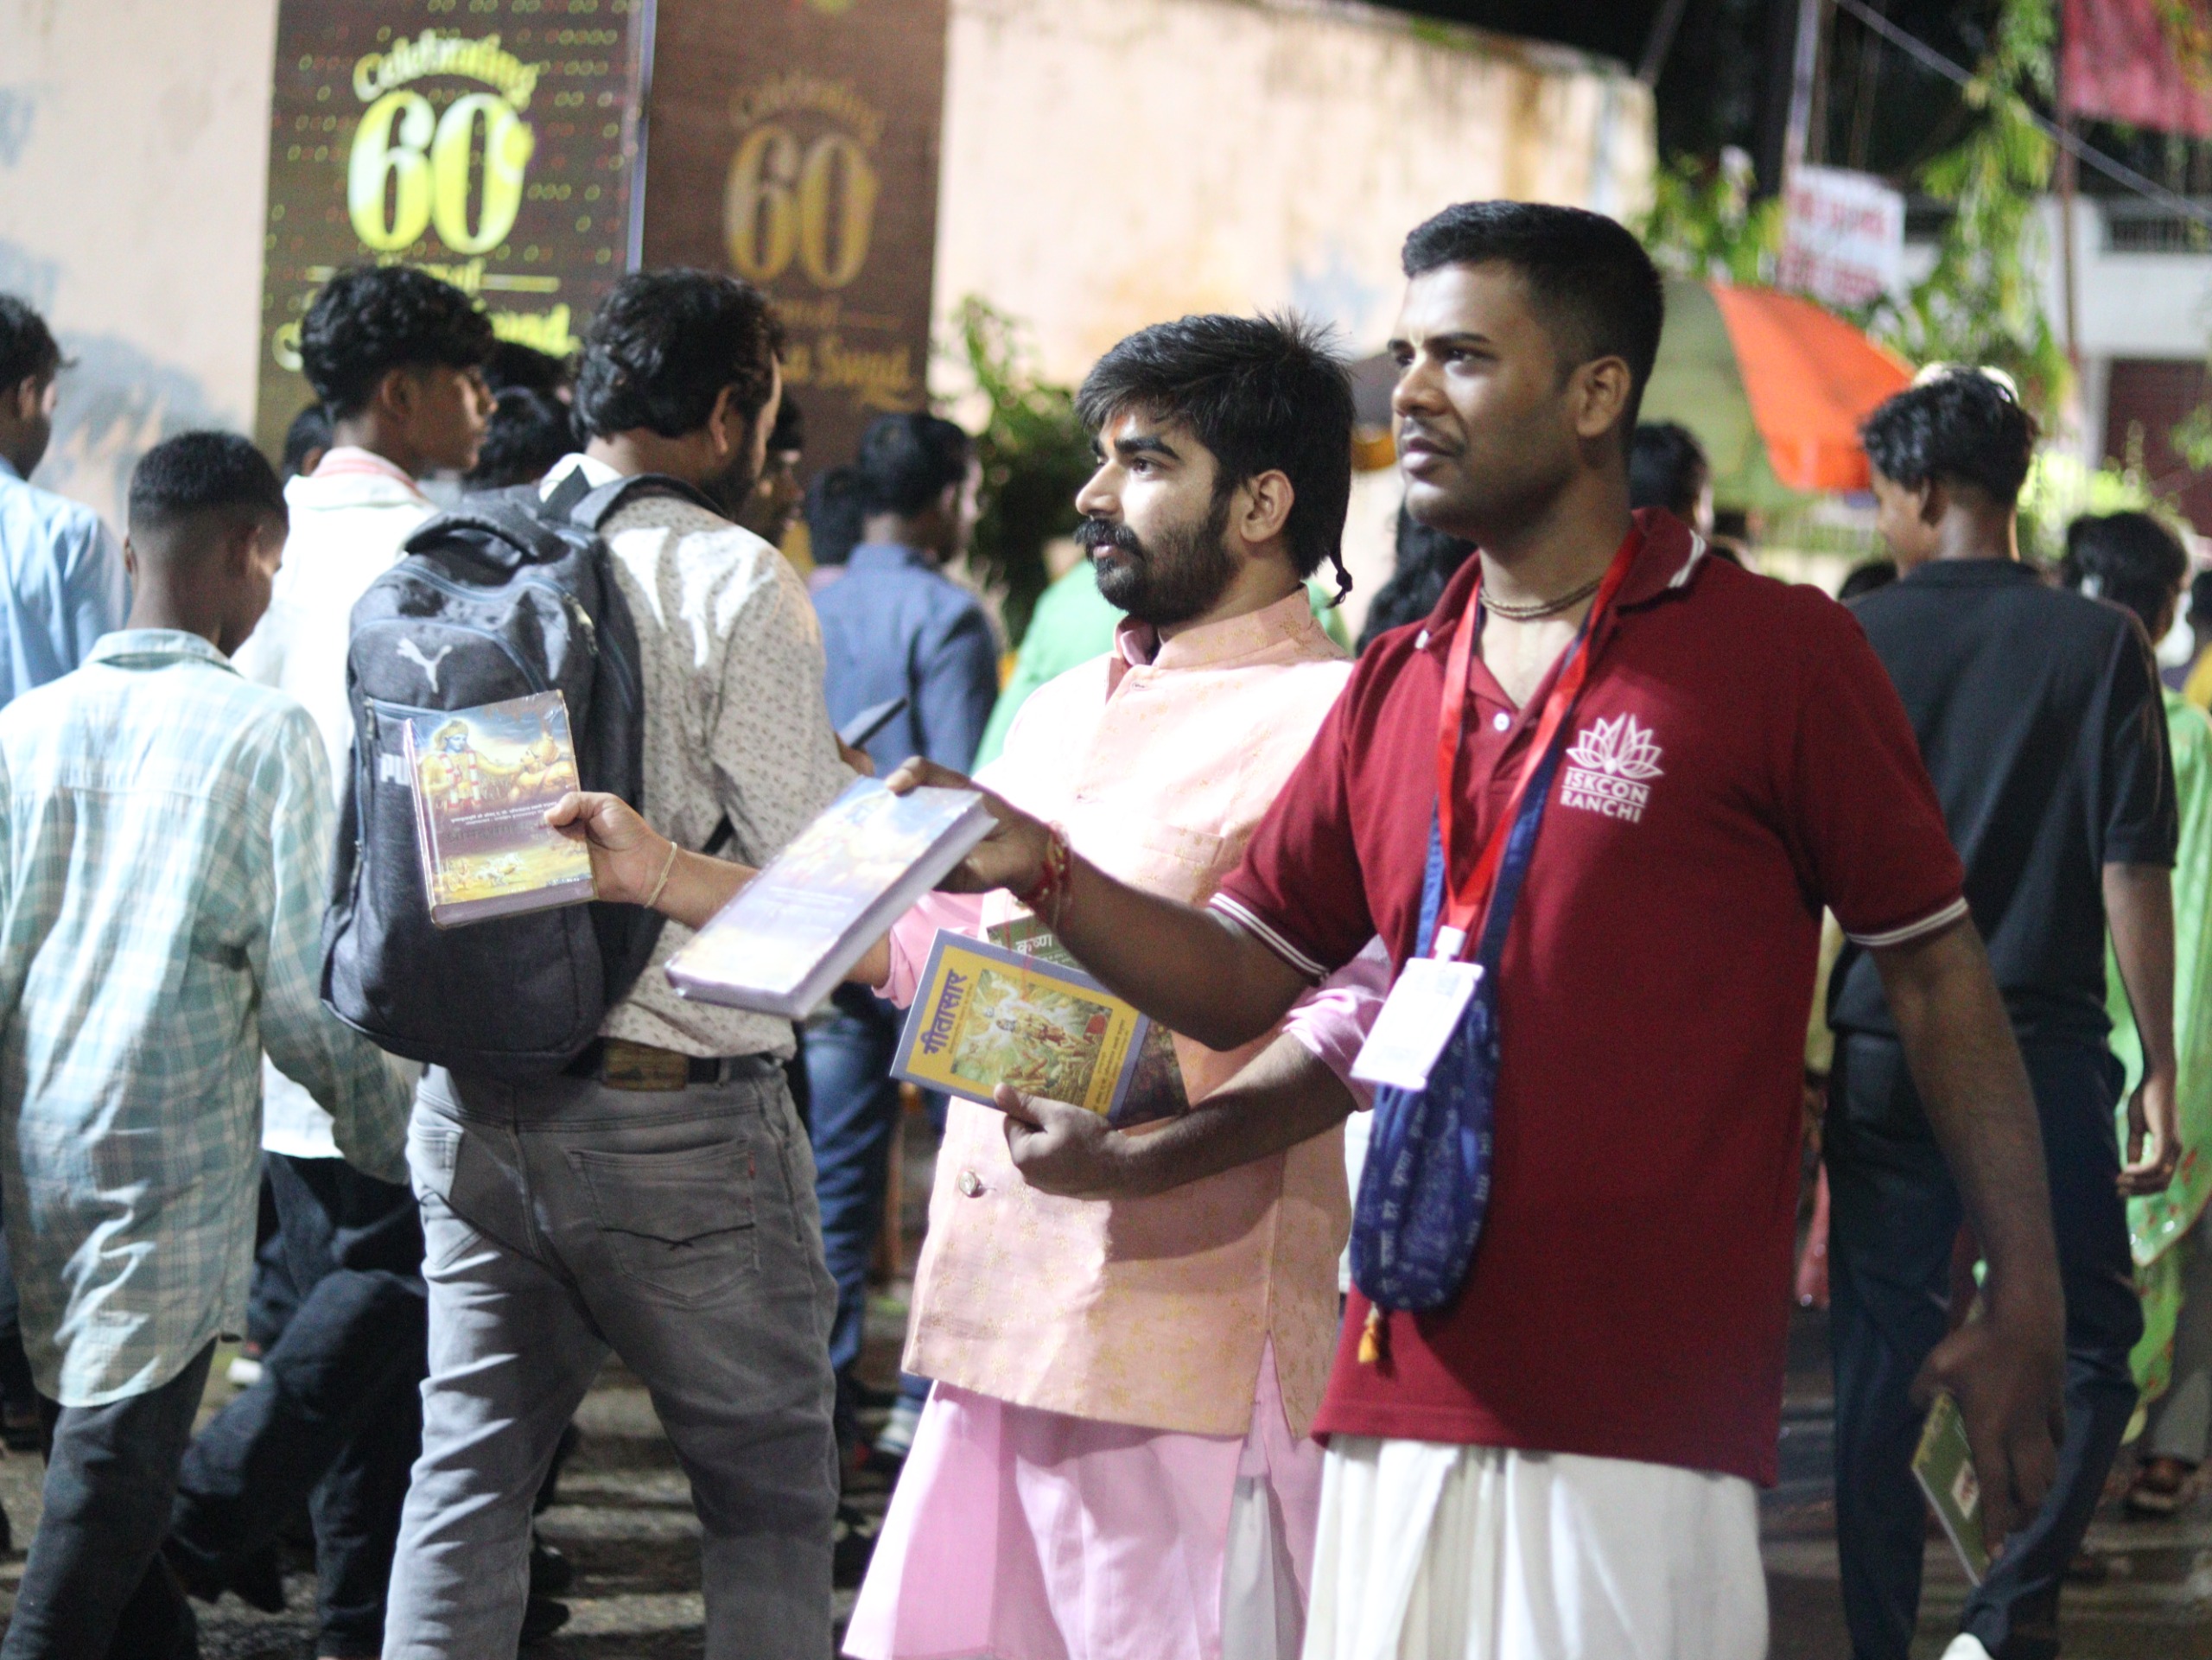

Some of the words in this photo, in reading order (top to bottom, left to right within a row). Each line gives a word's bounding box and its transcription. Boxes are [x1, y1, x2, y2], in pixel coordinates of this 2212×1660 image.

[380, 753, 410, 785] PU
[1564, 771, 1649, 805] ISKCON
[1560, 788, 1642, 824] RANCHI
[920, 968, 968, 1056] गीतासार
